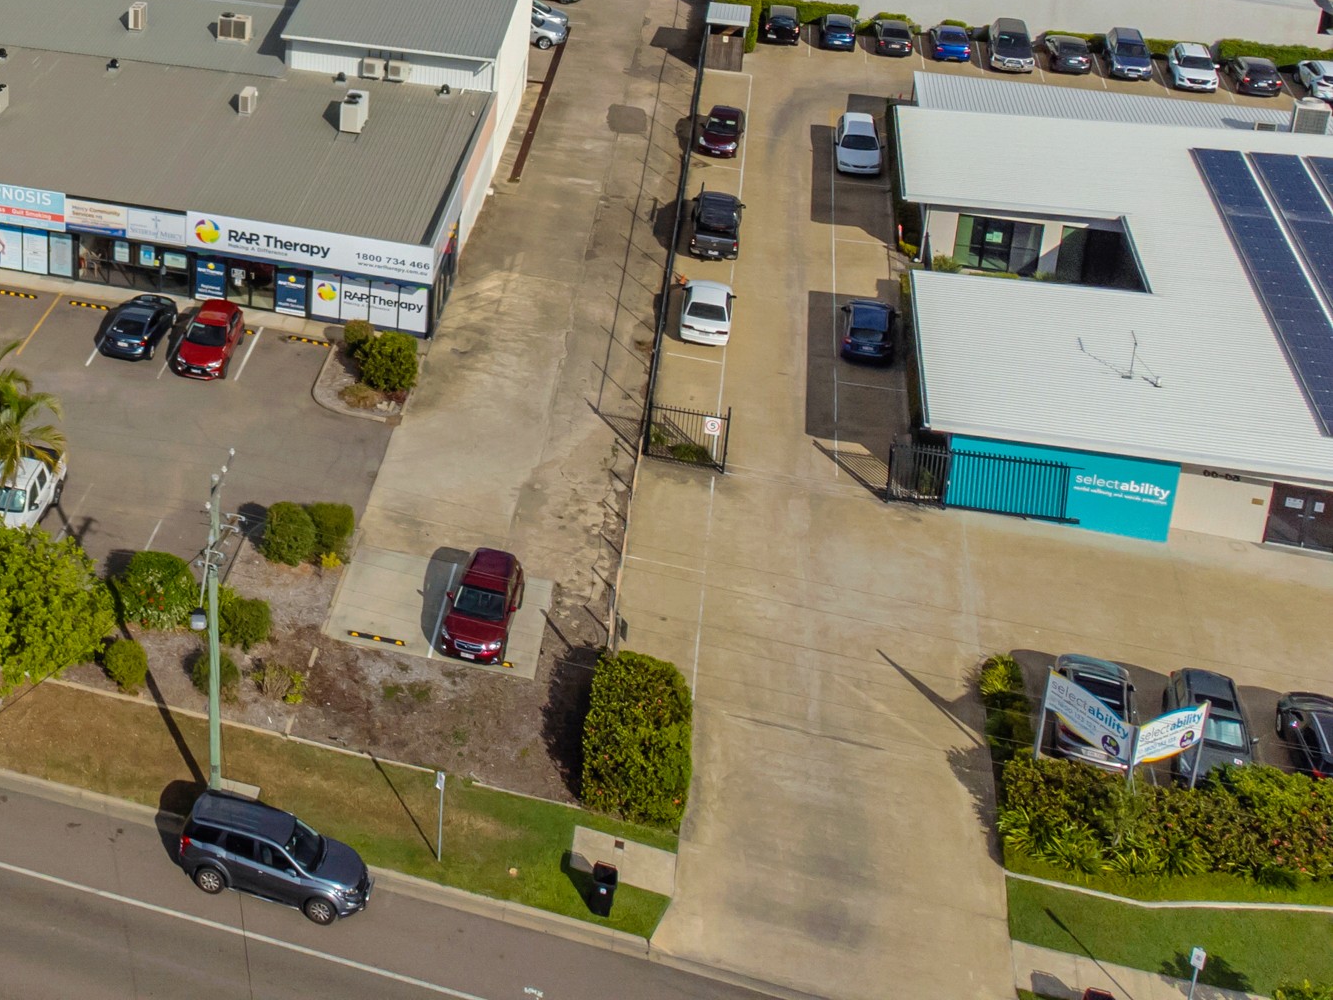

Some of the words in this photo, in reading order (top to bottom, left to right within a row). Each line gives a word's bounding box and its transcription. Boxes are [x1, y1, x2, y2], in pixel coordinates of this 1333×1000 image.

[12, 208, 24, 216] Quit
[26, 210, 52, 220] Smoking
[228, 243, 248, 251] Making
[257, 248, 288, 256] Difference
[263, 235, 330, 259] Therapy
[356, 252, 382, 262] 1800
[386, 257, 405, 266] 734
[410, 261, 430, 270] 466
[370, 295, 423, 313] Therapy
[1076, 474, 1170, 500] selectability
[1052, 680, 1128, 739] selectability
[1140, 713, 1202, 742] selectability
